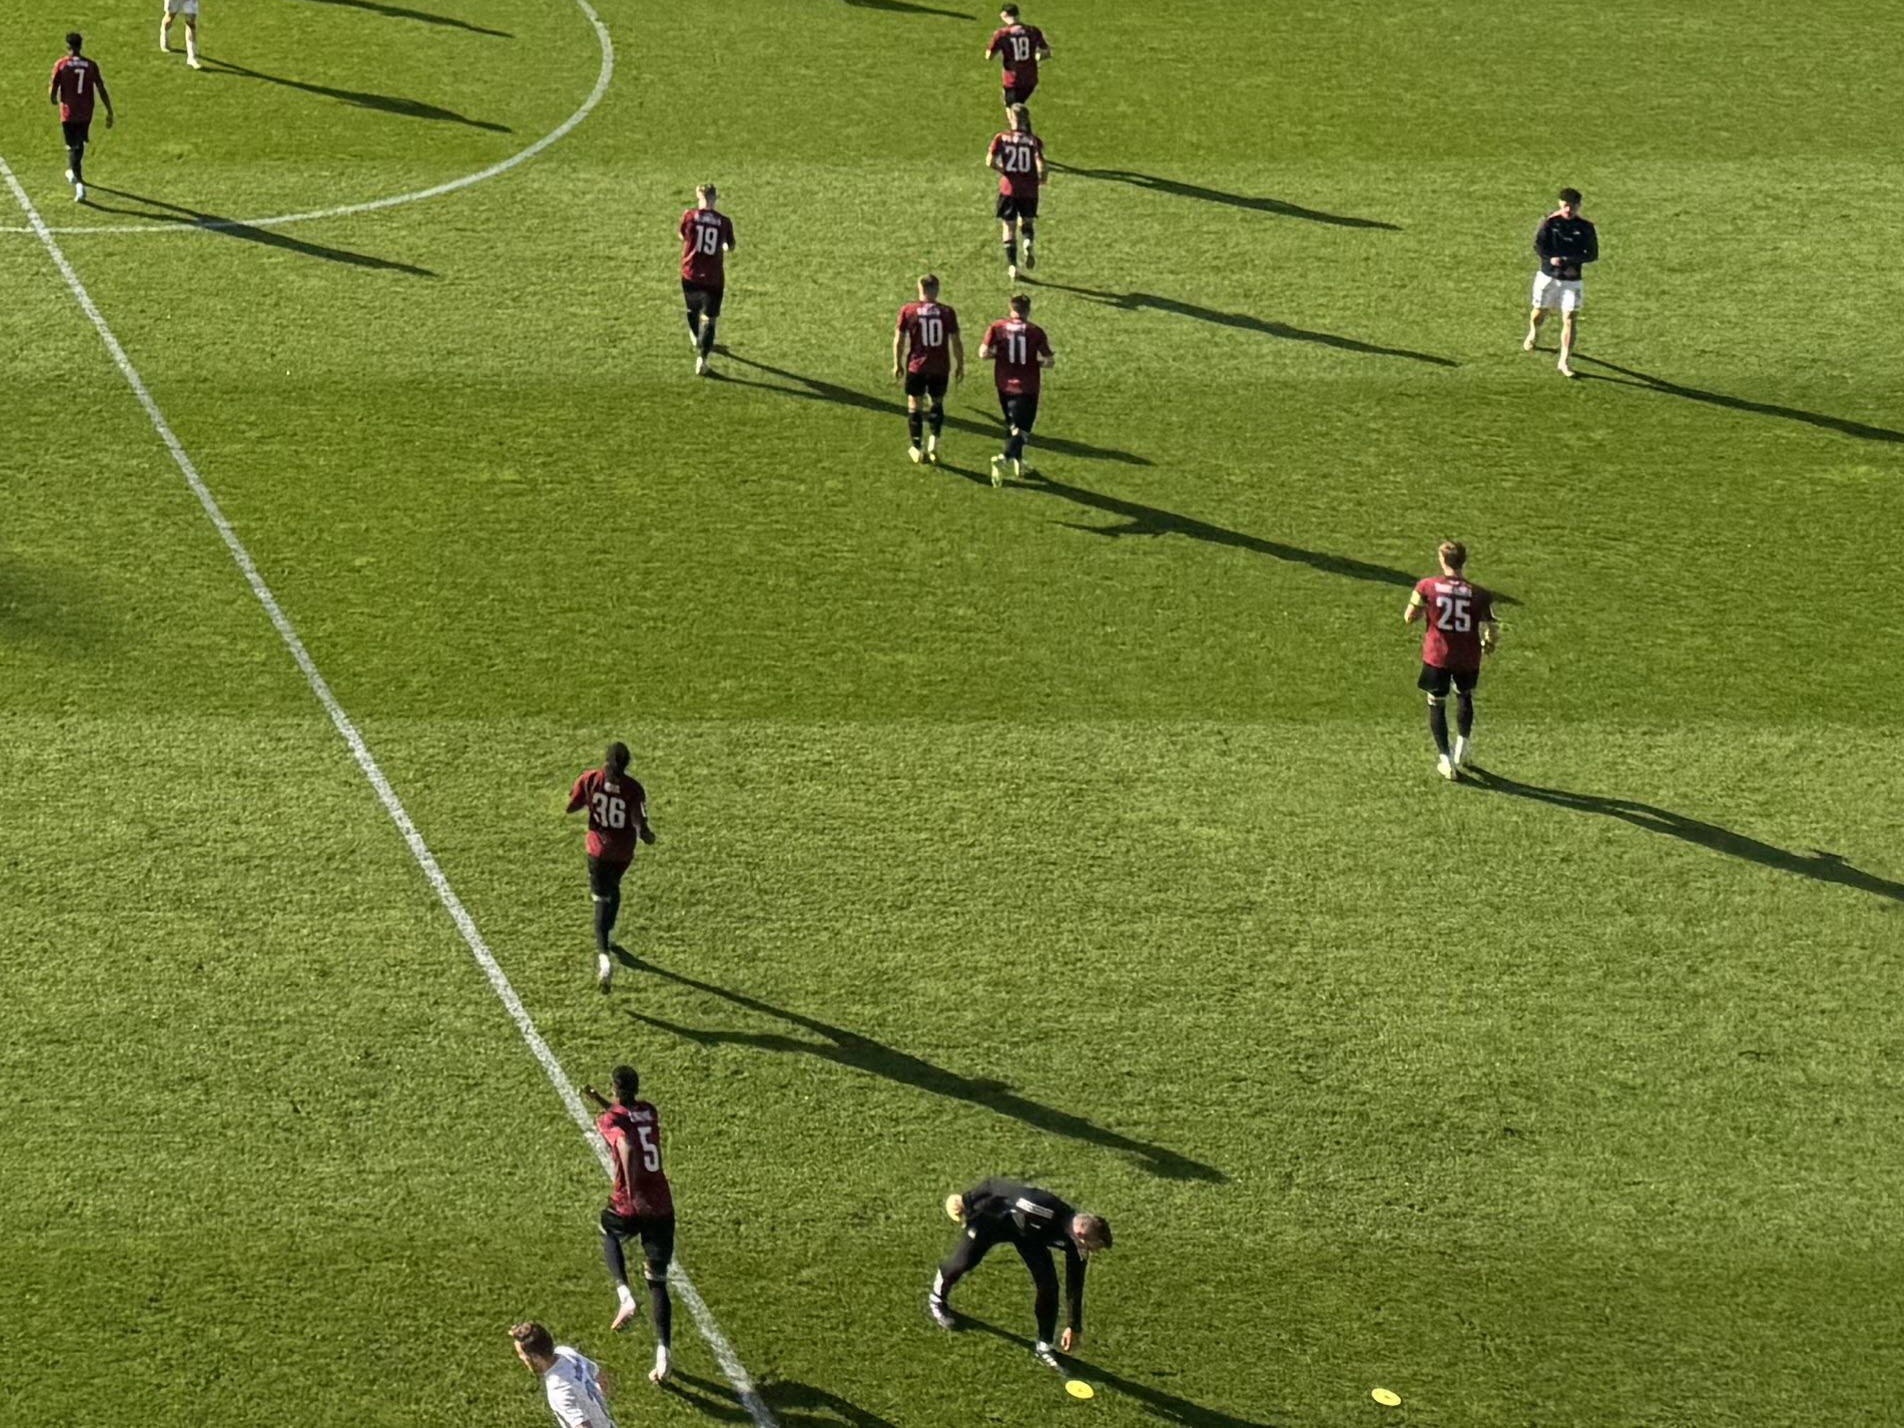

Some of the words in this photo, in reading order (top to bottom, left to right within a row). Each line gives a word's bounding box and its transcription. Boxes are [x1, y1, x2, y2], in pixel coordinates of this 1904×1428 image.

[1009, 36, 1030, 62] 18
[74, 68, 85, 94] 7
[1004, 145, 1031, 173] 20
[695, 224, 719, 256] 19
[918, 317, 943, 347] 10
[1007, 333, 1027, 365] 11
[1436, 595, 1471, 632] 25
[592, 791, 626, 829] 36
[637, 1126, 660, 1173] 5
